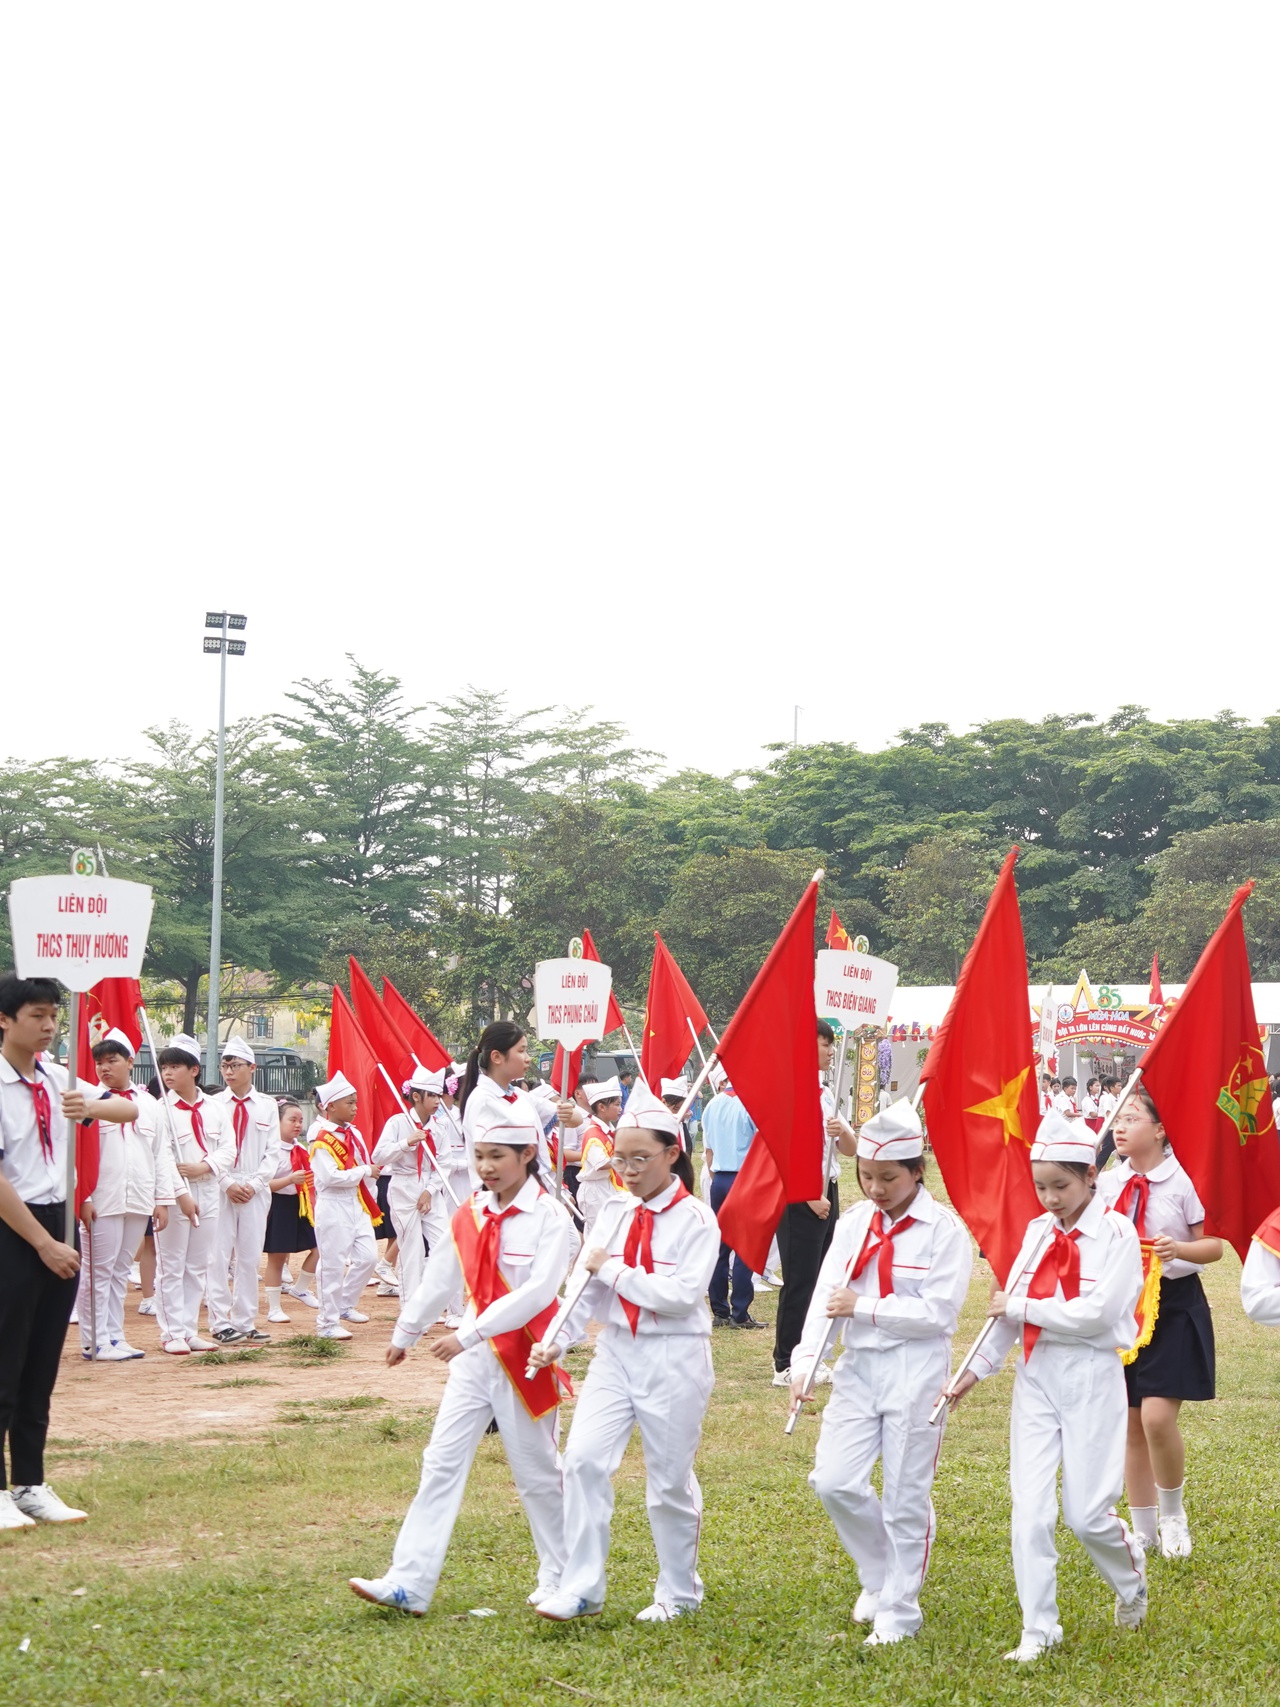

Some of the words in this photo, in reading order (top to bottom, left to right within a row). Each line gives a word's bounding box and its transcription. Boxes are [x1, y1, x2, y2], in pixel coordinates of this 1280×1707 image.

[75, 852, 94, 876] 85
[58, 893, 84, 913] LIÊN
[88, 894, 107, 917] ĐỘI
[37, 933, 62, 957] THCS
[94, 933, 128, 958] HƯƠNG
[561, 972, 576, 988] LIÊN
[577, 972, 588, 991] ĐỘI
[843, 964, 859, 978] LIÊN
[860, 967, 872, 983] ĐỘI
[826, 989, 841, 1008] THCS
[857, 995, 877, 1014] GIANG
[1097, 985, 1123, 1009] 85
[547, 1005, 562, 1024] THCS
[583, 1000, 598, 1023] CHÂU
[1057, 1026, 1068, 1037] ĐỘI
[1068, 1026, 1076, 1034] TA
[1089, 1022, 1100, 1031] LÊN
[1101, 1023, 1117, 1032] CÙNG
[1118, 1024, 1131, 1034] ĐẤT
[1130, 1027, 1146, 1040] NƯỚC
